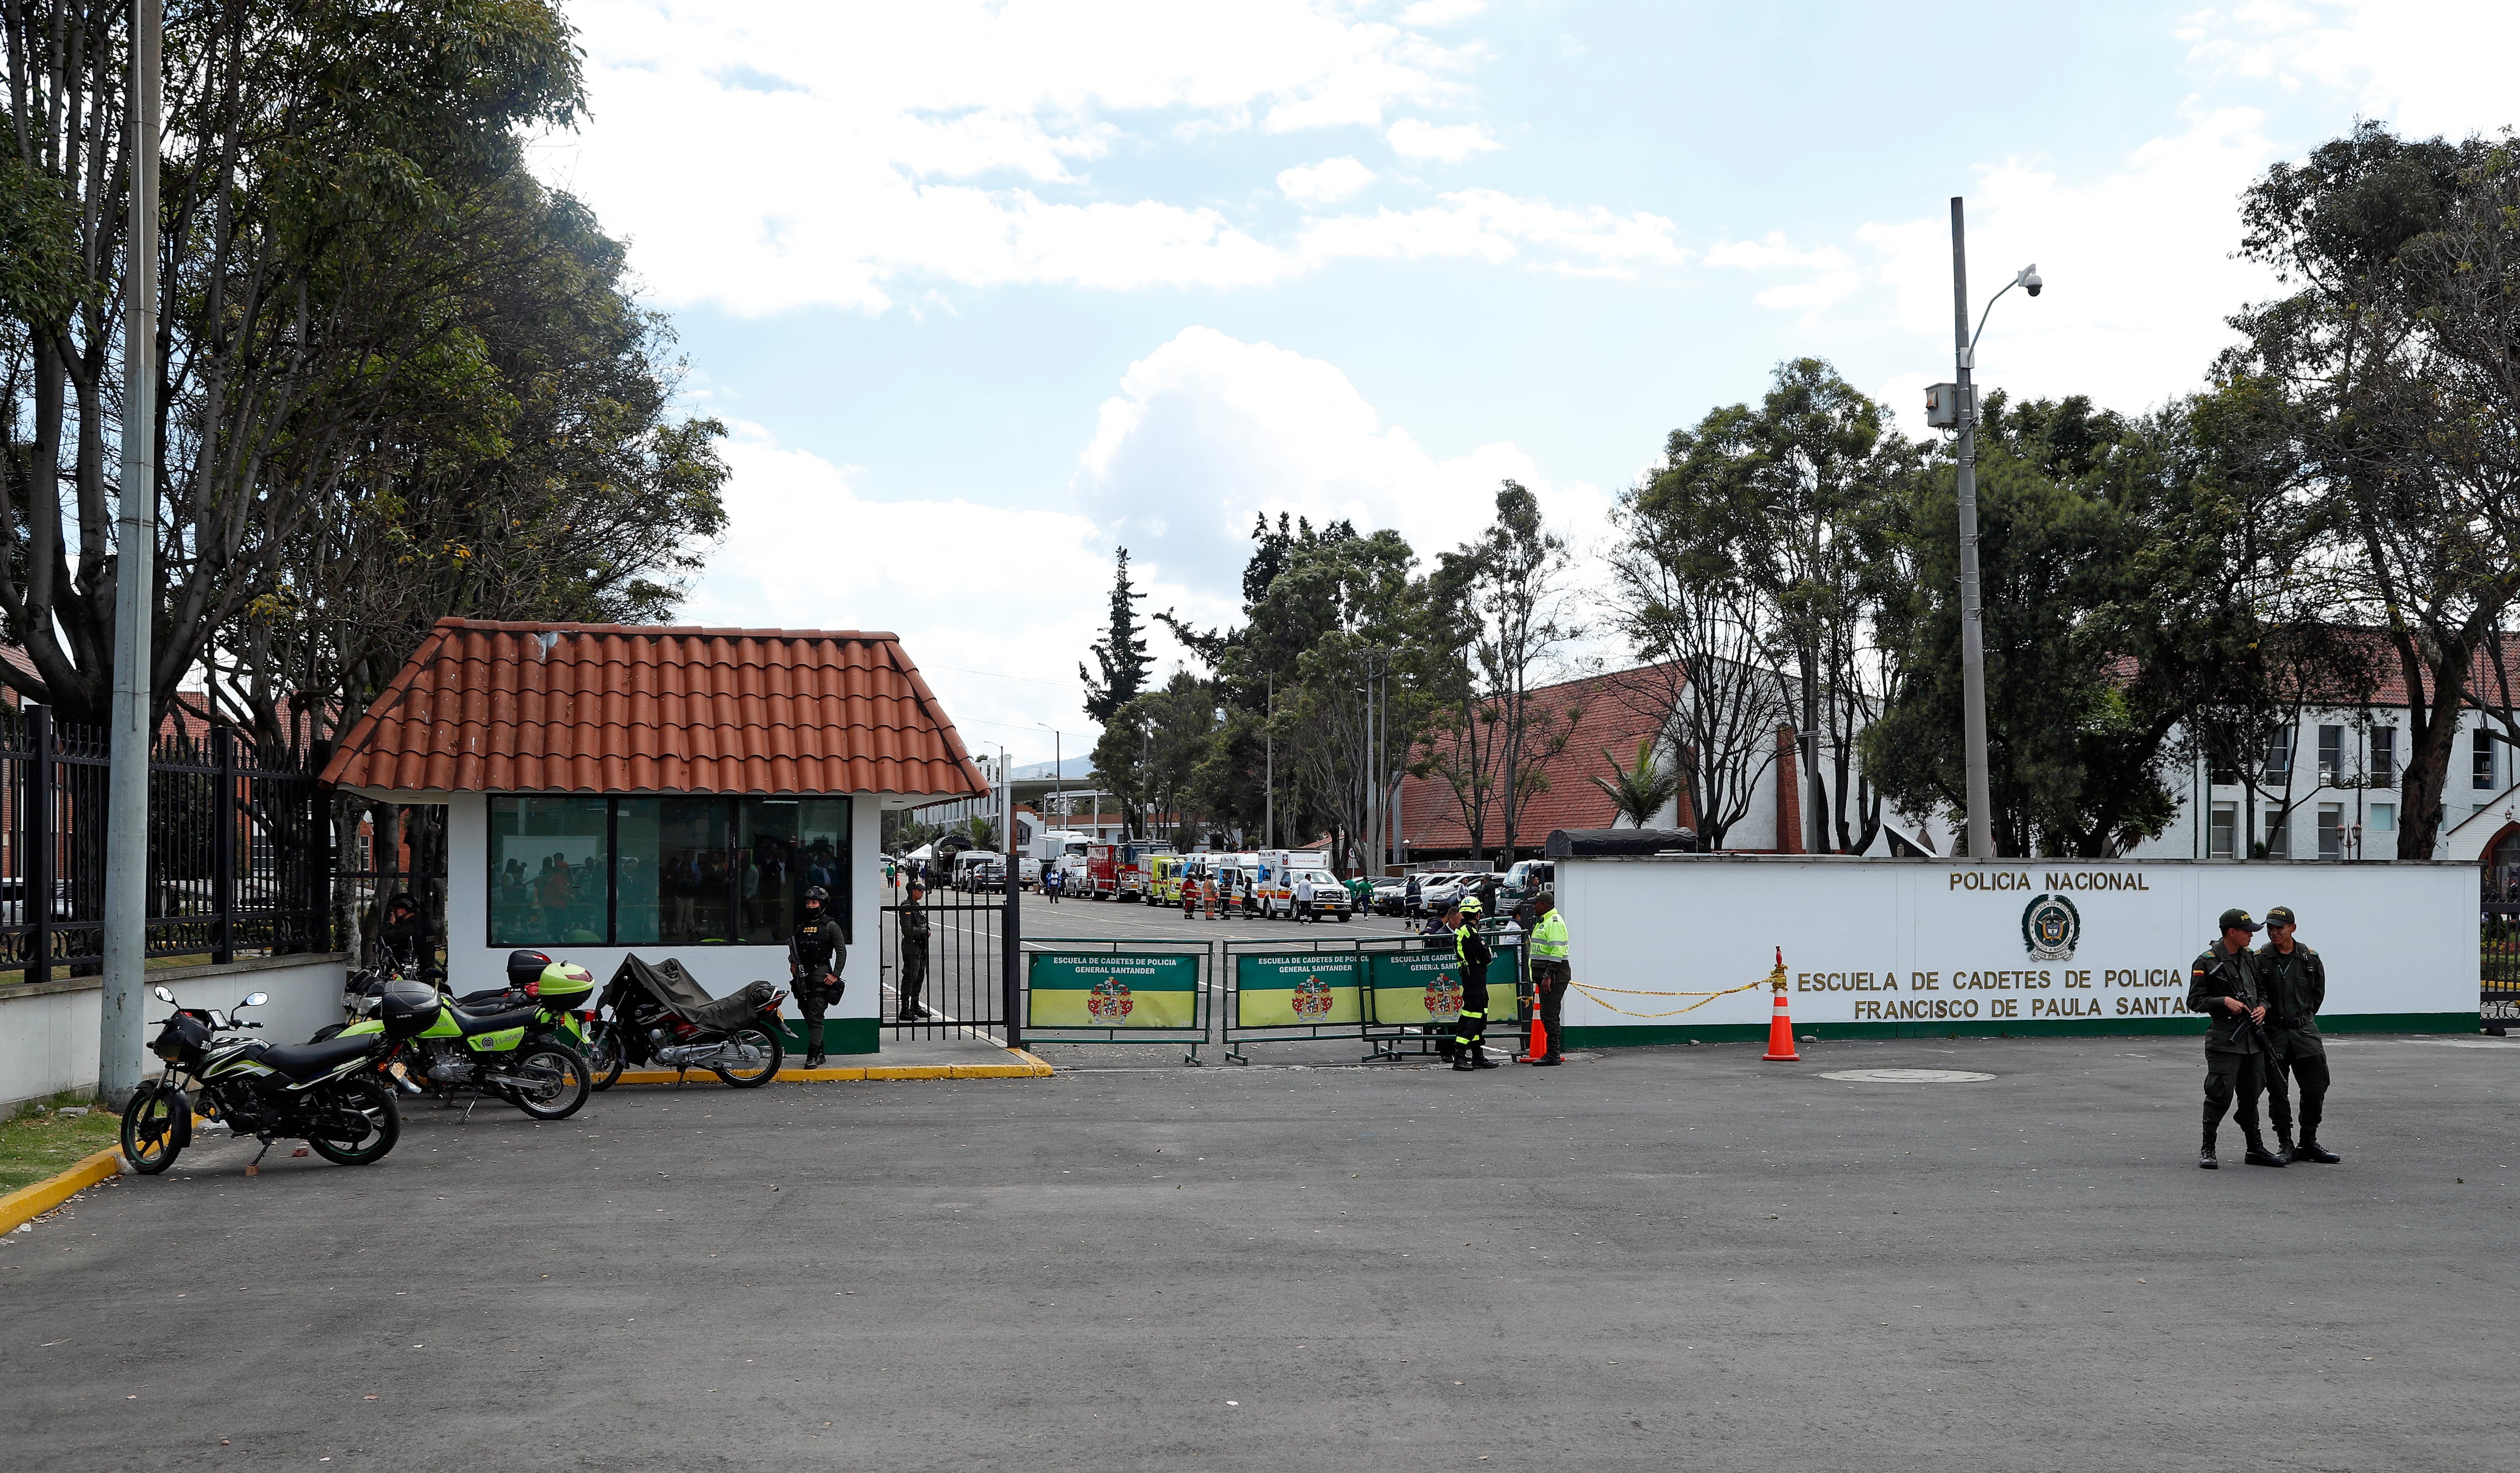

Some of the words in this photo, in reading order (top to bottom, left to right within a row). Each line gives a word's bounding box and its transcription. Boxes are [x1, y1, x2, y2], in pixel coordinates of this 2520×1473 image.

[1950, 872, 2031, 890] POLICIA
[2046, 872, 2149, 890] NACIONAL
[2059, 904, 2073, 926] COLOMBIA
[1798, 972, 1898, 992] ESCUELA
[1912, 972, 1939, 990] DE
[1953, 970, 2051, 990] CADETES
[2065, 970, 2091, 988] DE
[2105, 969, 2182, 988] POLICIA
[1855, 1000, 1979, 1019] FRANCISCO
[1991, 999, 2018, 1017] DE
[2032, 998, 2102, 1016] PAULA
[2116, 997, 2190, 1015] SANTA
[495, 1032, 522, 1046] 15-0045
